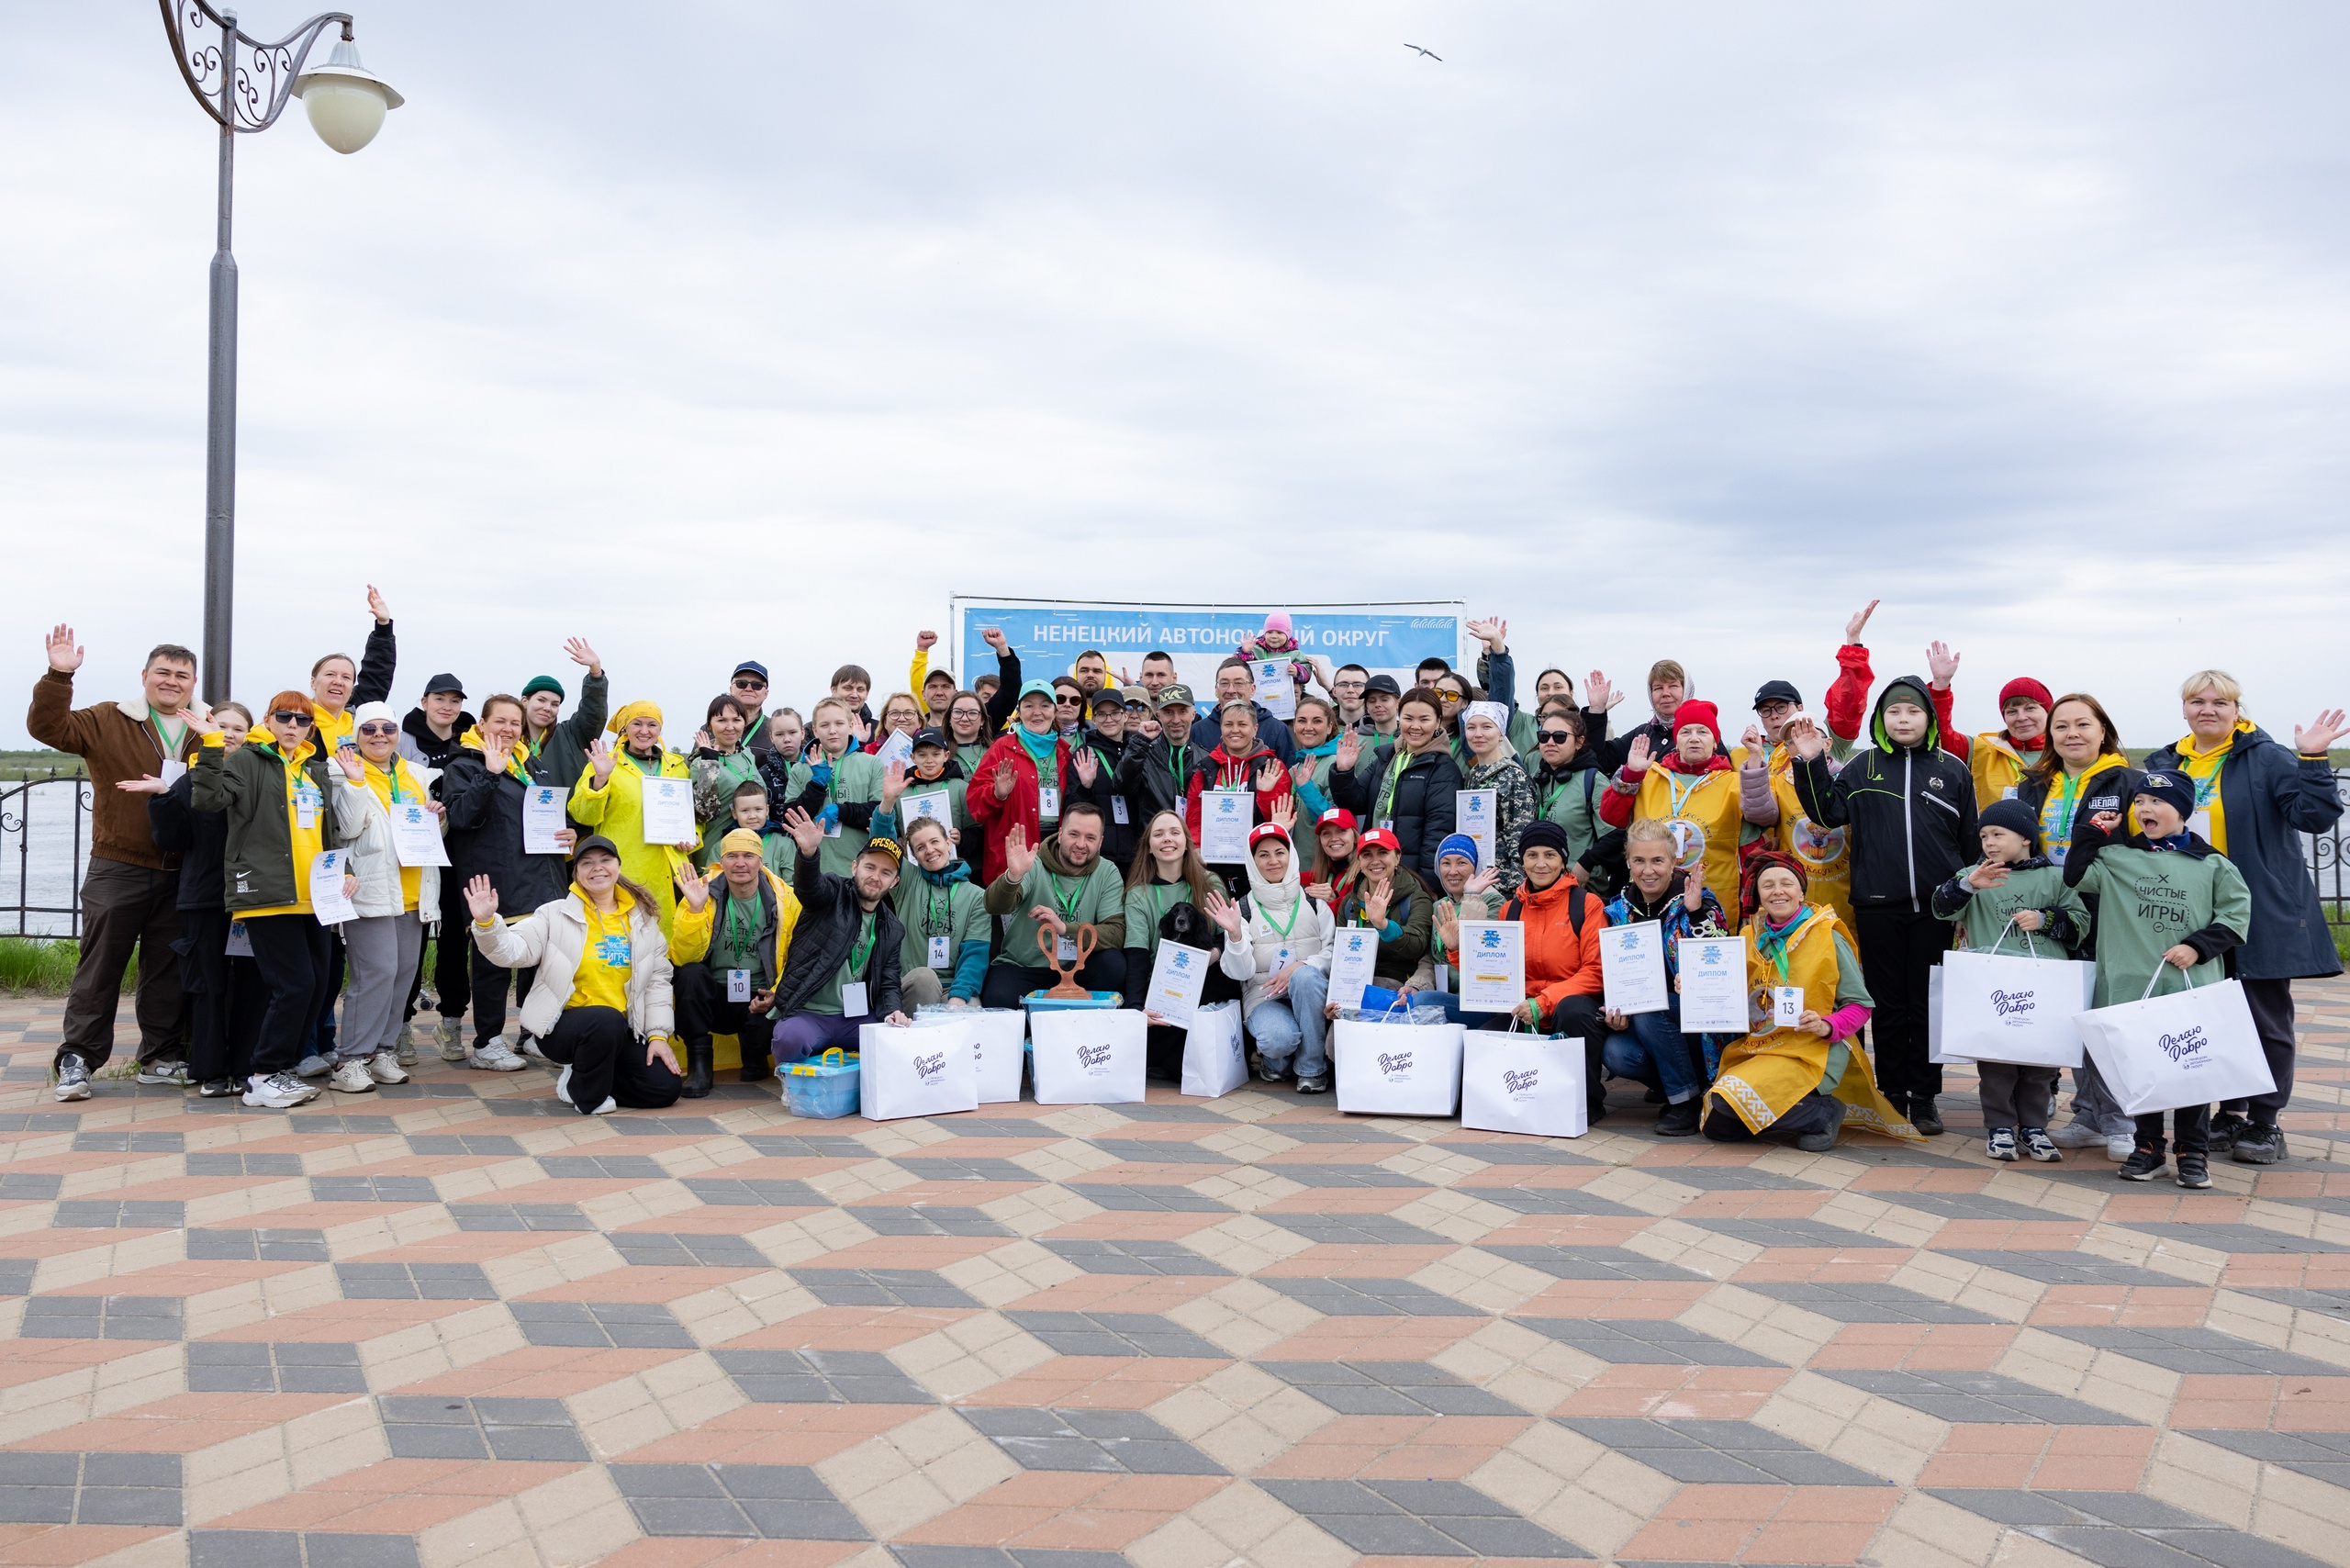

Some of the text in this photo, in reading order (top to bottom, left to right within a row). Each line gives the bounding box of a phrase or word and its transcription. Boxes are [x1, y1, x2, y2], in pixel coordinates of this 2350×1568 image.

[1034, 622, 1153, 646] НЕНЕЦКИЙ
[1322, 630, 1390, 647] ОКРУГ
[1046, 799, 1052, 808] 8
[2090, 797, 2120, 808] ДЕЛАЙ
[1117, 806, 1123, 816] 3
[869, 837, 902, 859] PFCSOCHI
[2139, 885, 2188, 901] ЧИСТЫЕ
[2138, 903, 2186, 924] ИГРЫ
[934, 949, 944, 959] 14
[1618, 953, 1646, 964] ДИПЛОМ
[1279, 960, 1285, 970] 7
[1166, 969, 1191, 980] ДИПЛОМ
[1698, 969, 1728, 978] ДИПЛОМ
[733, 982, 744, 992] 10
[1990, 990, 2034, 1005] Делаю
[1782, 1002, 1795, 1014] 13
[1996, 999, 2035, 1016] Добро
[2158, 1025, 2202, 1052] Делаю
[1077, 1043, 1111, 1059] Делаю
[2168, 1036, 2208, 1062] Добро
[913, 1051, 944, 1070] Делаю
[1081, 1051, 1112, 1070] Добро
[1377, 1051, 1413, 1066] Делаю
[918, 1059, 946, 1080] Добро
[1382, 1058, 1414, 1075] Добро
[1503, 1069, 1539, 1083] Делаю
[1506, 1076, 1539, 1094] Добро
